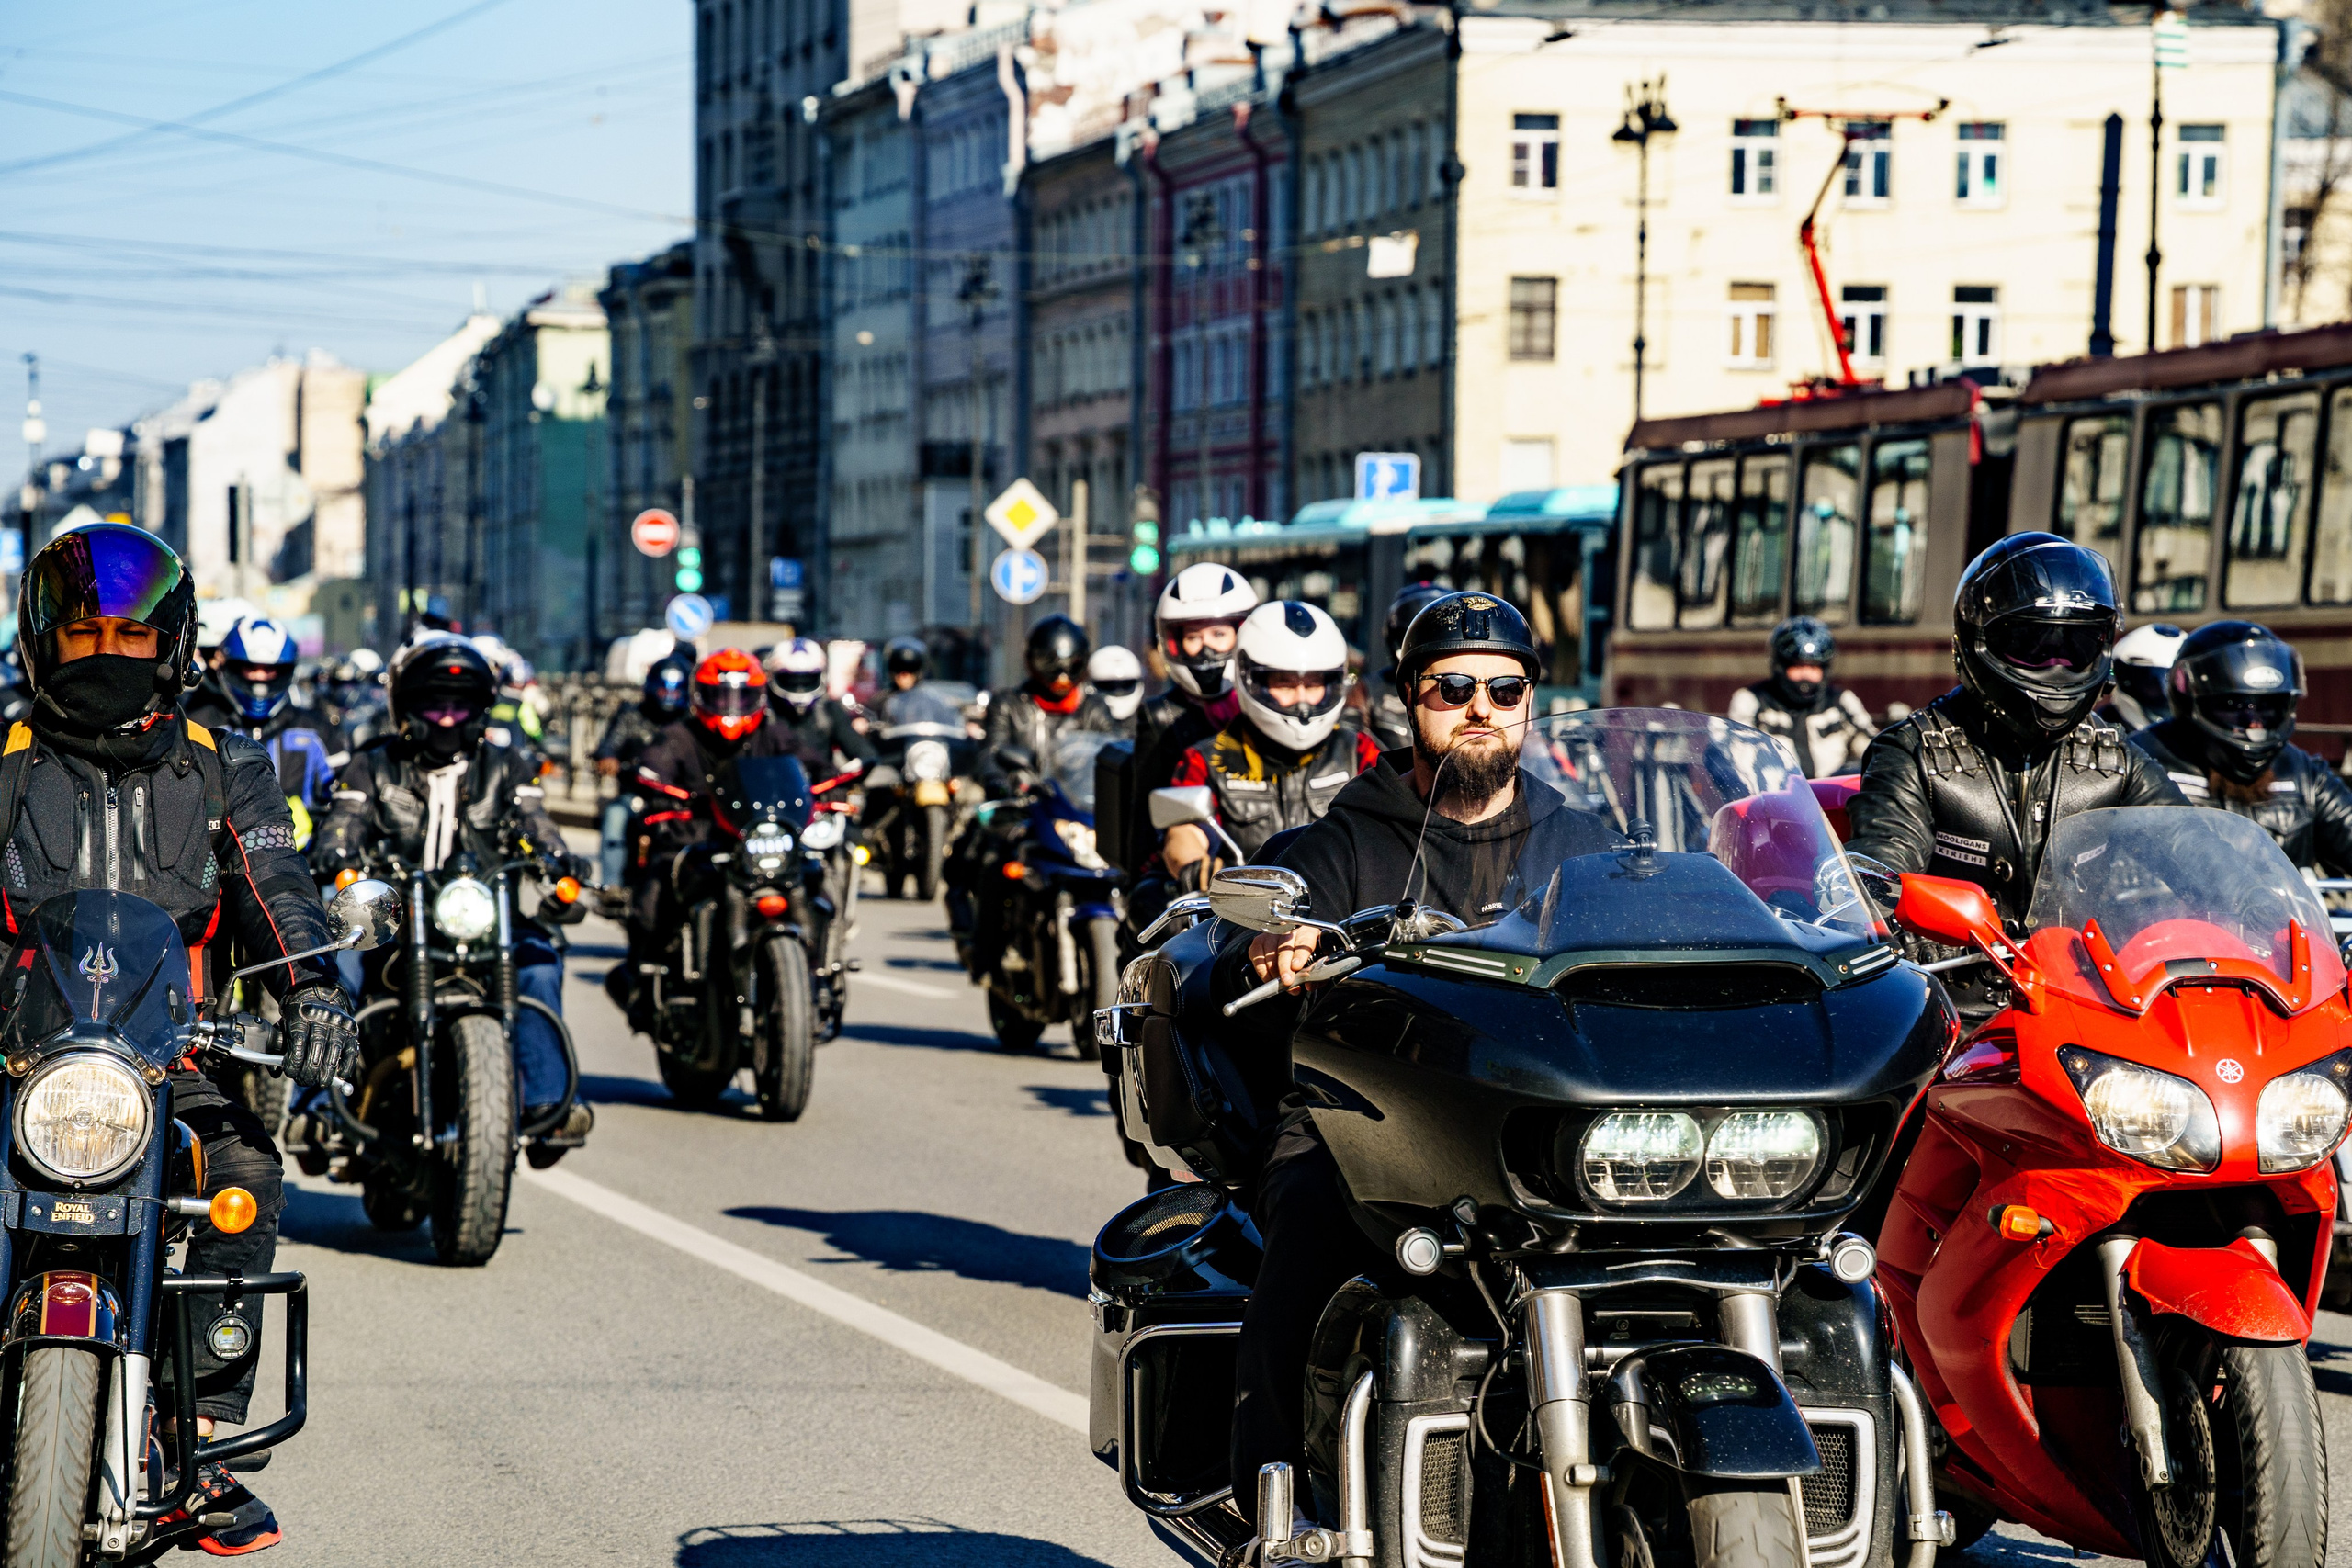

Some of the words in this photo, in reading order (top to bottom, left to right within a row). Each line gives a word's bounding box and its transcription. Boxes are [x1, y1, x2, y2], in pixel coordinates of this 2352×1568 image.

[1937, 832, 1987, 850] HOOLIGANS
[1938, 846, 1983, 863] KIRISHI
[55, 1201, 90, 1213] ROYAL
[51, 1212, 95, 1224] ENFIELD
